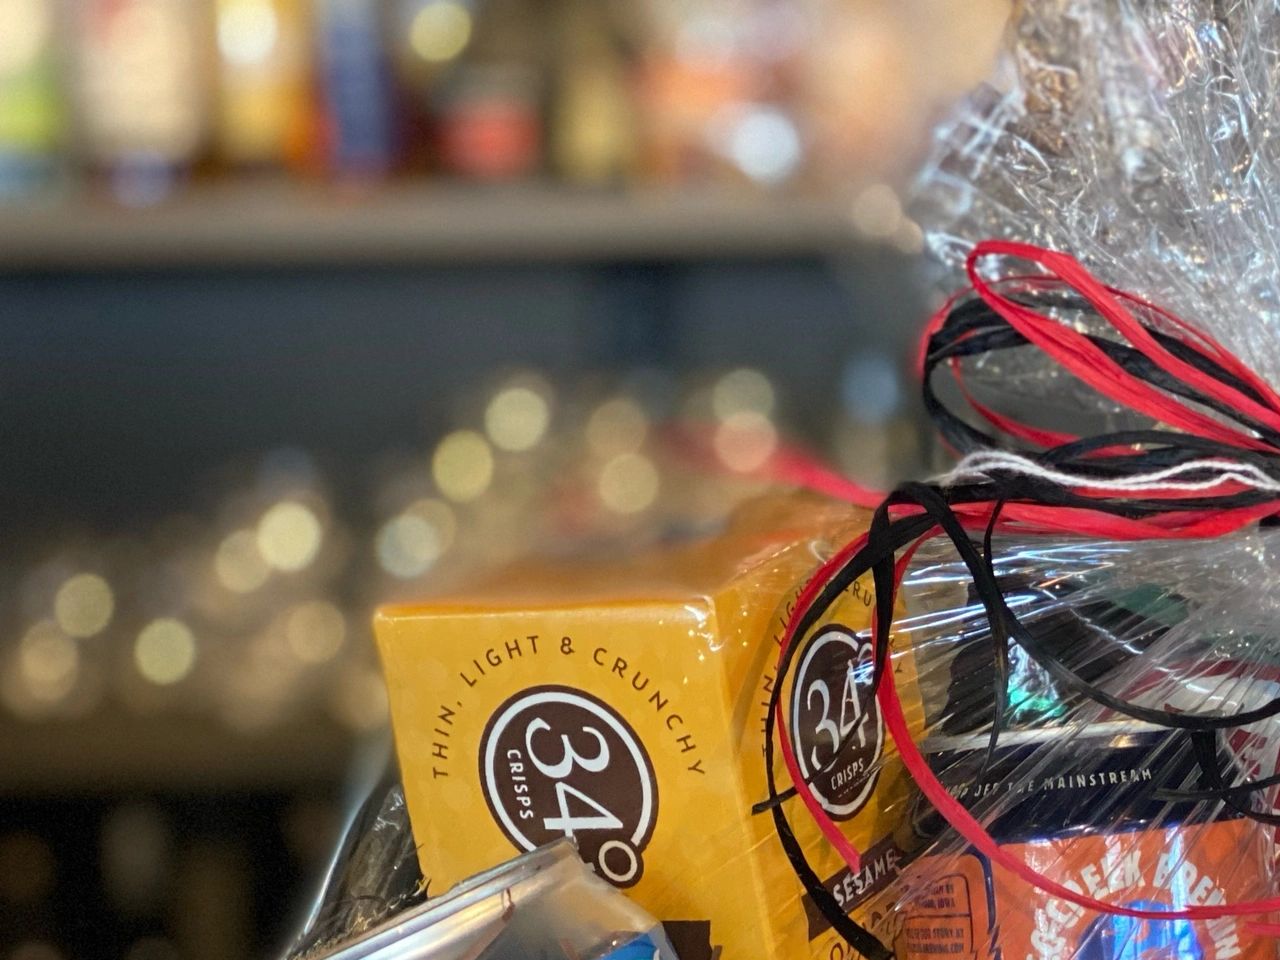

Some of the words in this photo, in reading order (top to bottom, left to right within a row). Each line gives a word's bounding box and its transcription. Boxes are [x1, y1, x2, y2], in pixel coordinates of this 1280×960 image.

[432, 701, 465, 780] THIN,
[461, 635, 541, 689] LIGHT
[559, 636, 576, 656] &
[592, 646, 707, 777] CRUNCHY
[506, 748, 535, 821] CRISPS
[830, 756, 866, 791] CRISPS
[1043, 768, 1153, 791] MAINSTREAM
[832, 848, 901, 908] SESAME
